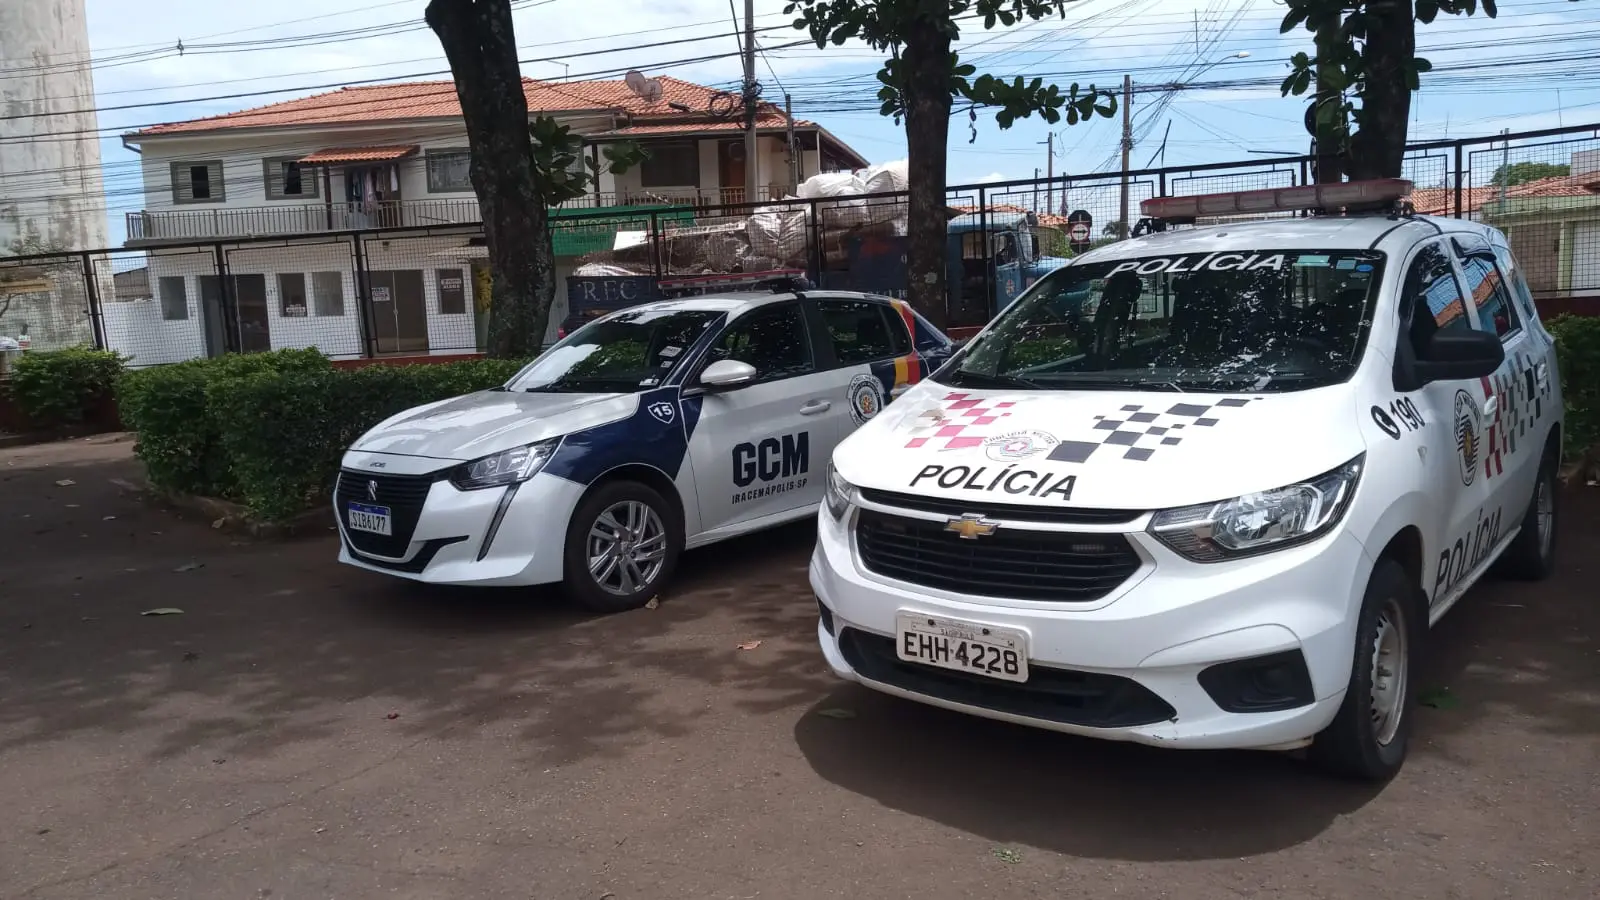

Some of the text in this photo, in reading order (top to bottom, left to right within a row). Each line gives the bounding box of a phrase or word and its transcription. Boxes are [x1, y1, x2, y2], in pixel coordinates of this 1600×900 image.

[1104, 251, 1285, 279] POLÍCIA
[653, 405, 672, 417] 15
[1389, 396, 1426, 433] 190
[732, 431, 809, 488] GCM
[908, 464, 1078, 501] POLÍCIA
[1429, 505, 1502, 608] POLÍCIA
